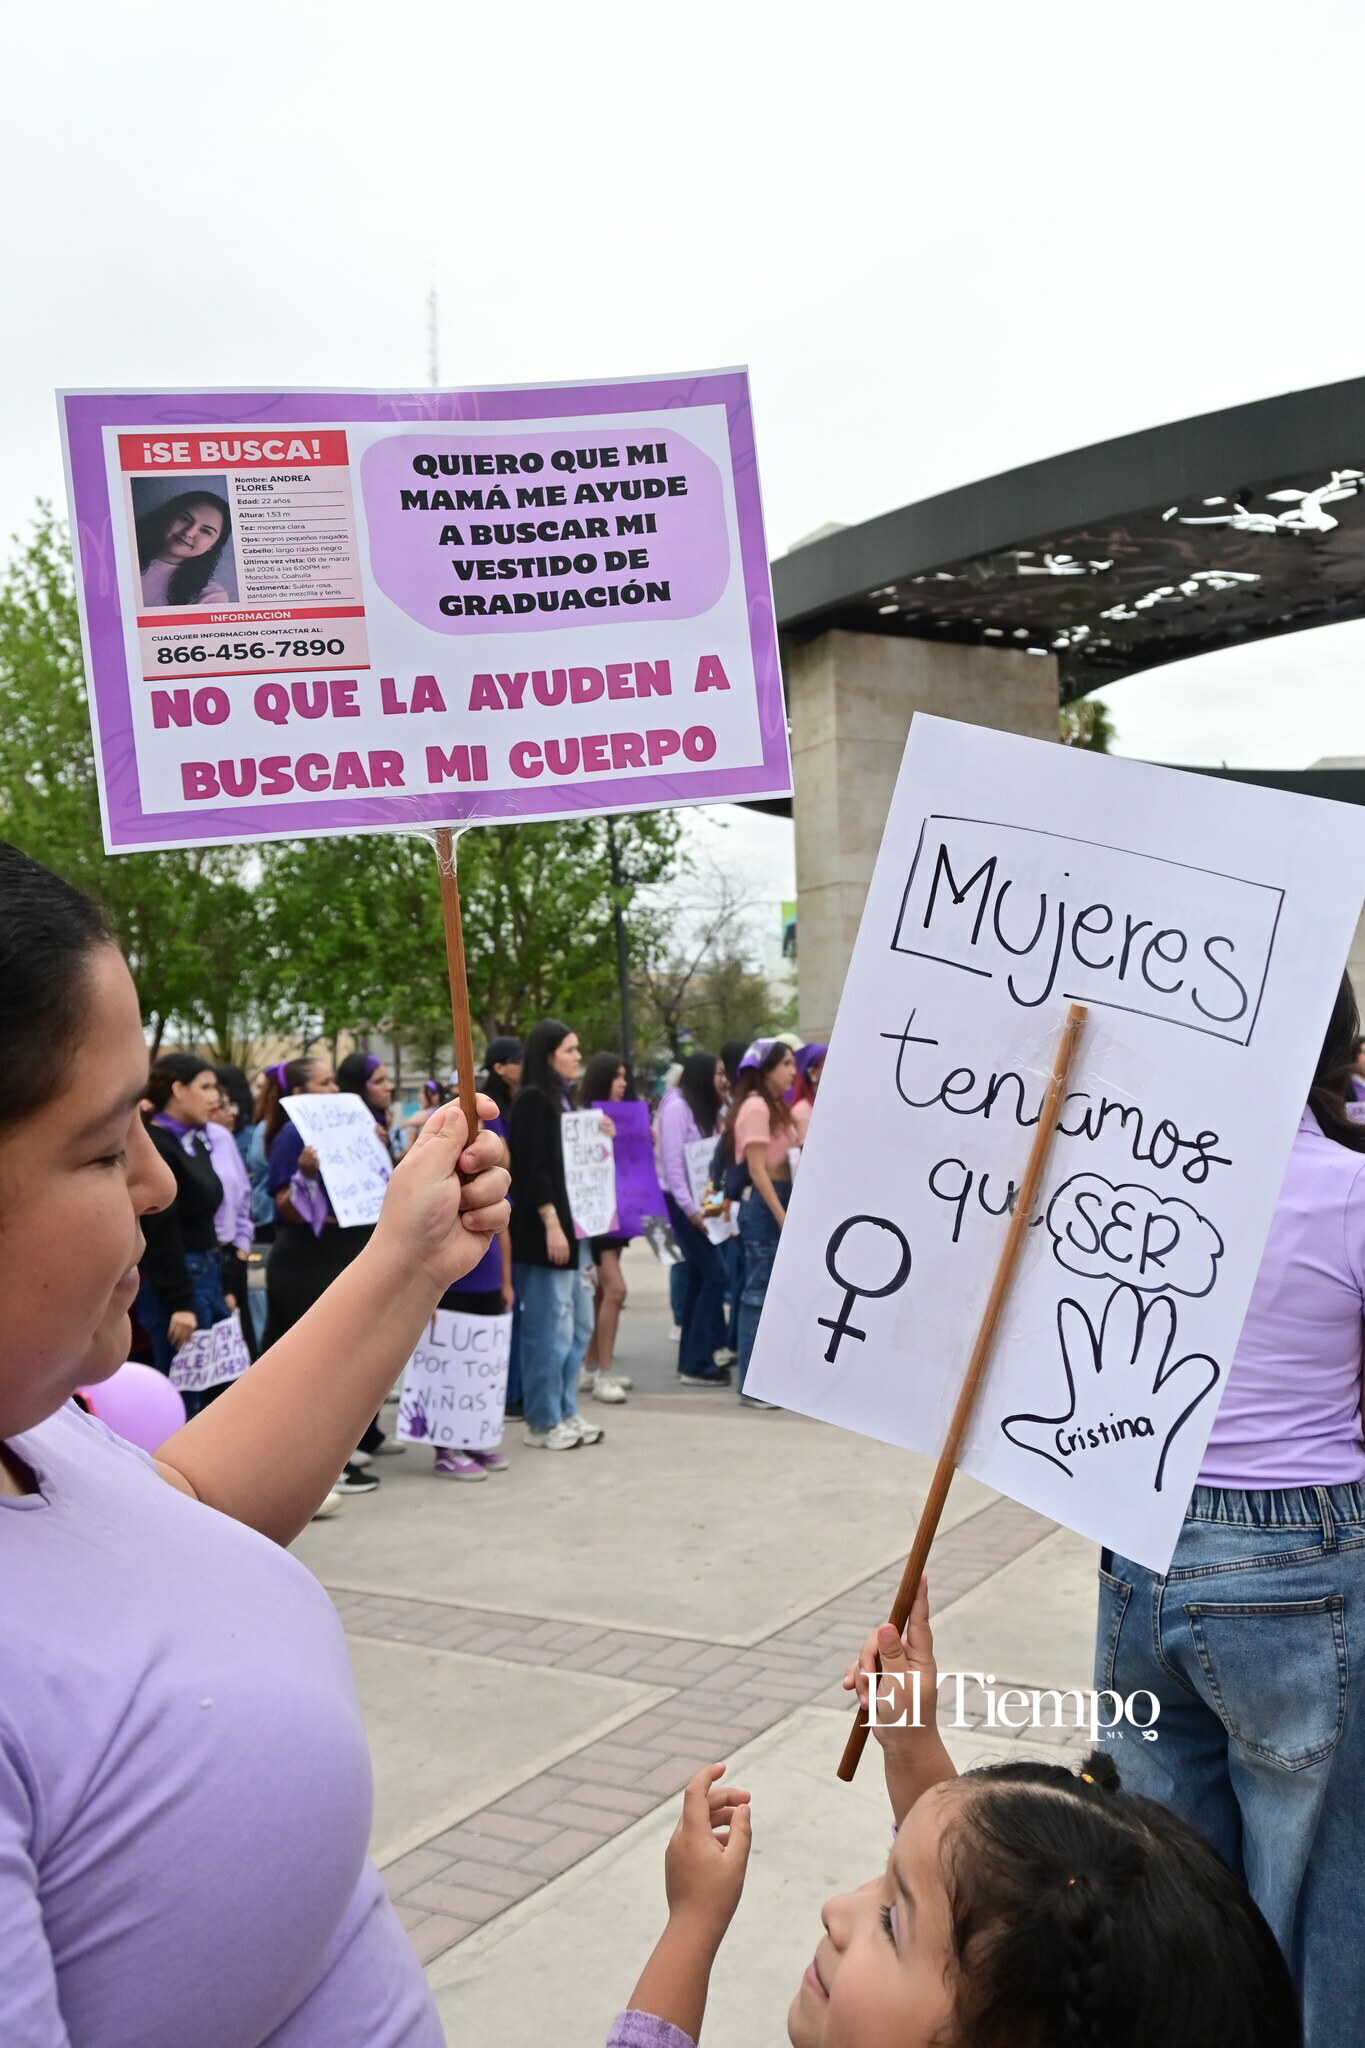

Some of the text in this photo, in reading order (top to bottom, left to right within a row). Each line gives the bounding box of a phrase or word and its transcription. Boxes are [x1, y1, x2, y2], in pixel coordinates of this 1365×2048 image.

[143, 439, 322, 464] ¡SE BUSCA!
[412, 442, 668, 479] QUIERO QUE MI
[234, 474, 311, 484] Nombre: ANDREA
[235, 484, 274, 492] FLORES
[399, 475, 688, 511] MAMÁ ME AYUDE
[262, 535, 284, 543] negros
[286, 534, 318, 542] pequeños
[319, 533, 348, 541] rasgados
[438, 512, 658, 546] A BUSCAR MI
[275, 546, 295, 554] largo
[296, 545, 320, 553] rizado
[320, 545, 343, 553] negro
[451, 548, 650, 581] VESTIDO DE
[246, 584, 291, 592] Vestimenta:
[247, 591, 277, 600] pantalón
[438, 578, 672, 617] GRADUACIÓN
[210, 610, 291, 622] INFORMACIÓN
[151, 633, 199, 642] CUALQUIER
[200, 630, 259, 639] INFORMACIÓN
[260, 628, 309, 637] CONTACTAR
[156, 638, 345, 664] 866-456-7890
[150, 654, 731, 729] NO QUE LA AYUDEN A
[180, 725, 717, 800] BUSCAR MI CUERPO
[923, 843, 1248, 1022] Mujeres
[1065, 1191, 1181, 1275] SER
[1055, 1412, 1155, 1457] Cristina
